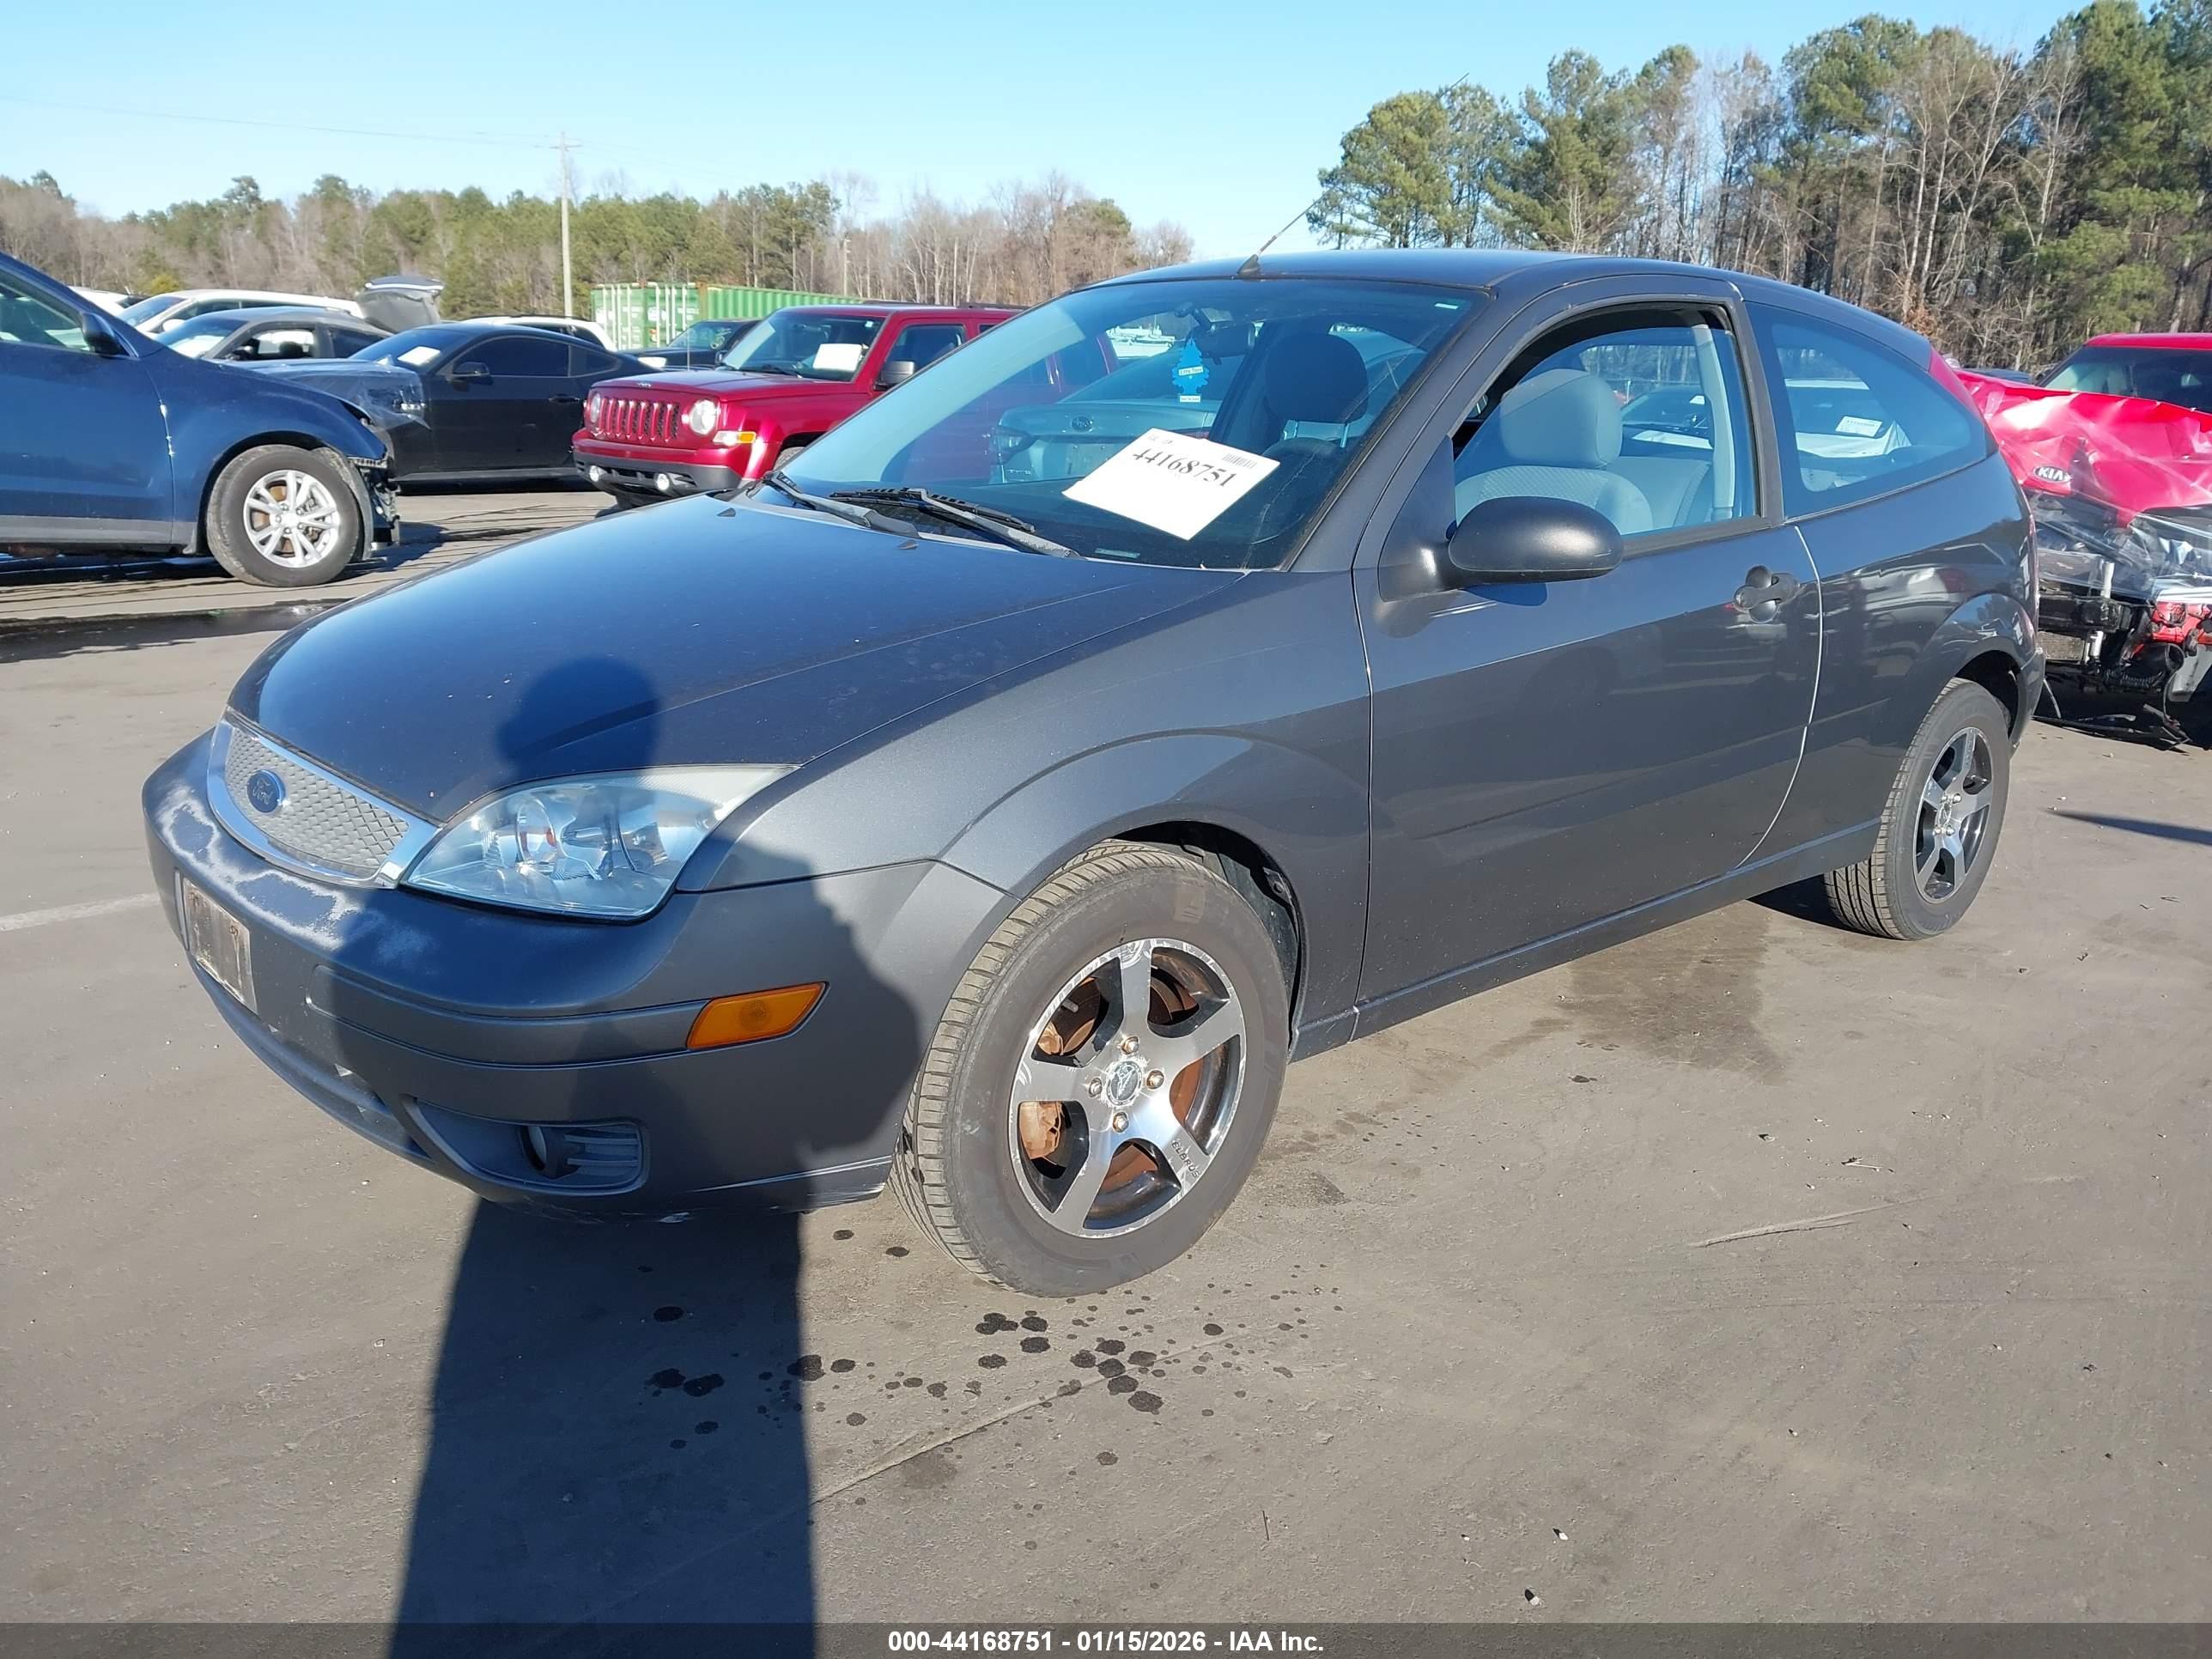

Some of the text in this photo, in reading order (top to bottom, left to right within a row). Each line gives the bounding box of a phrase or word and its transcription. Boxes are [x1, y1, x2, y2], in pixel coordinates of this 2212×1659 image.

[1133, 448, 1237, 487] 44168751
[2038, 466, 2063, 481] KIA
[1171, 1141, 1200, 1178] ELBRUS
